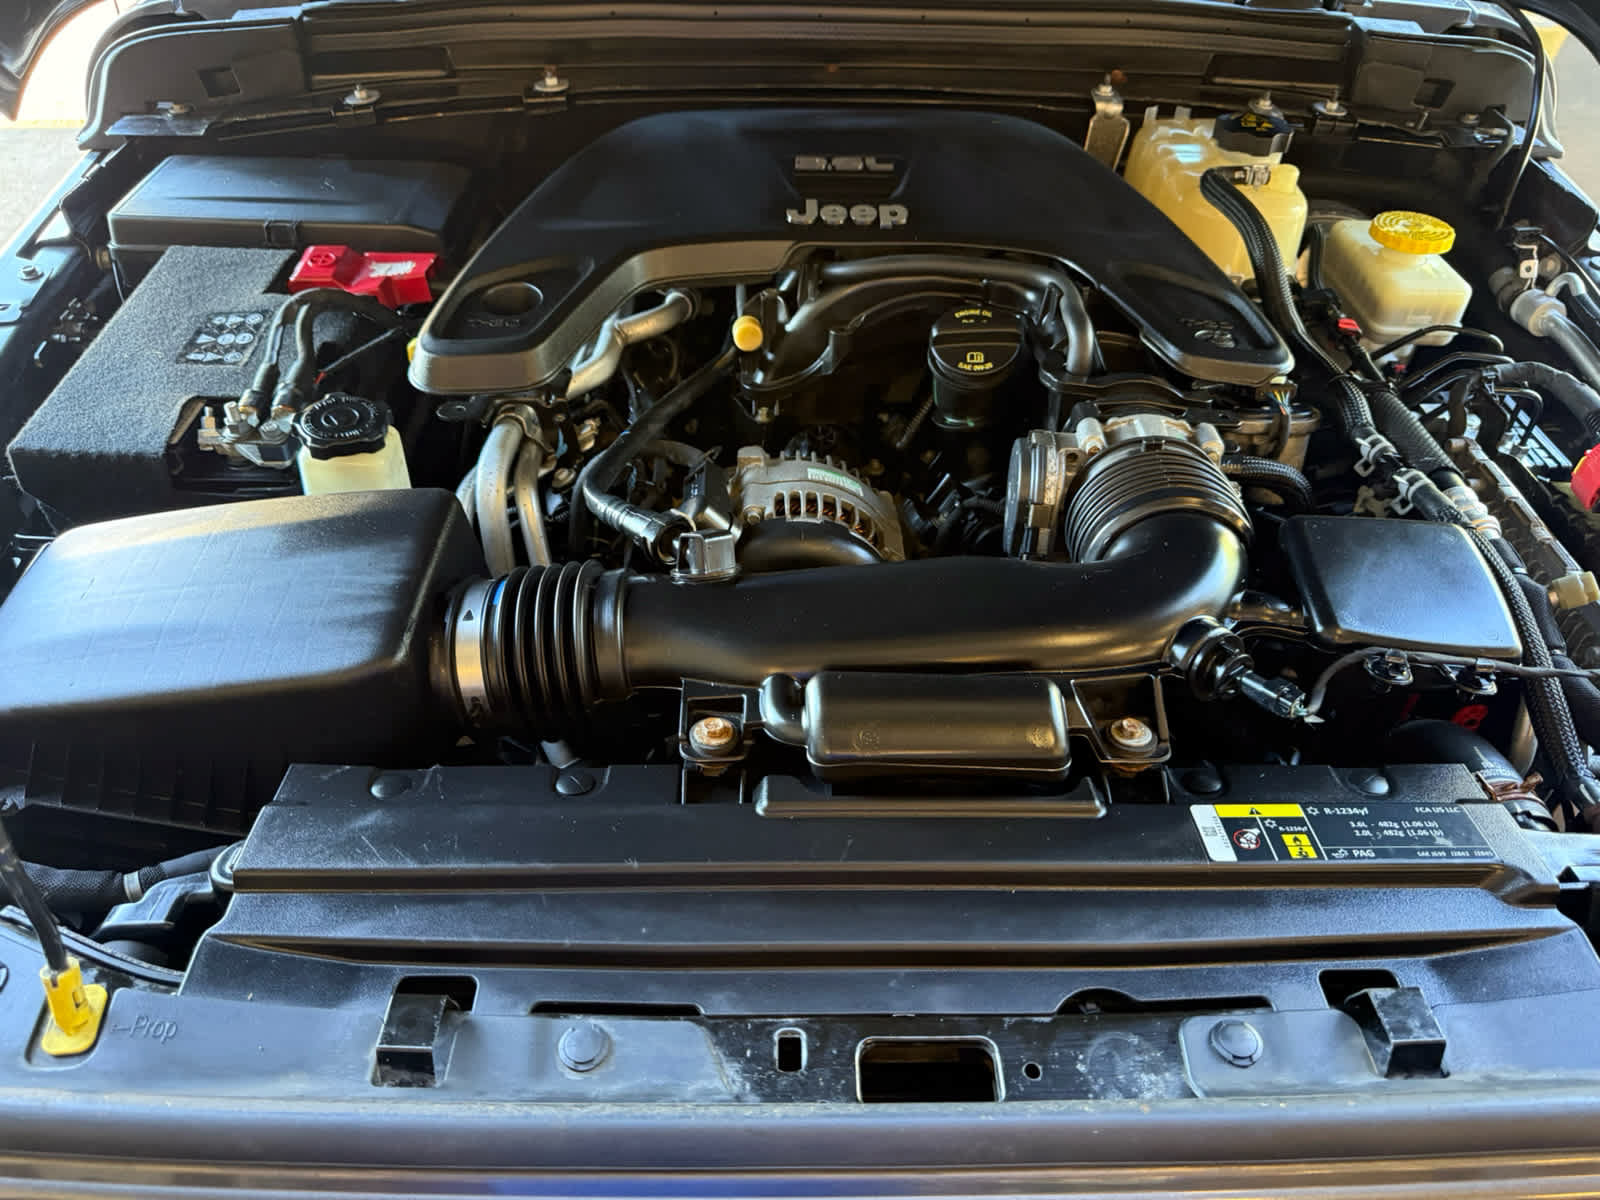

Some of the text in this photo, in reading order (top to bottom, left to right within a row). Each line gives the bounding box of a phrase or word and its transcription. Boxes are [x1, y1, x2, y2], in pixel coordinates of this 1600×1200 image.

[786, 199, 909, 230] Jeep
[954, 309, 993, 319] ENGINE OIL
[1323, 807, 1369, 816] R-1234yf
[1414, 806, 1432, 814] FCA
[1352, 849, 1376, 858] PAG
[131, 1015, 178, 1044] Prop
